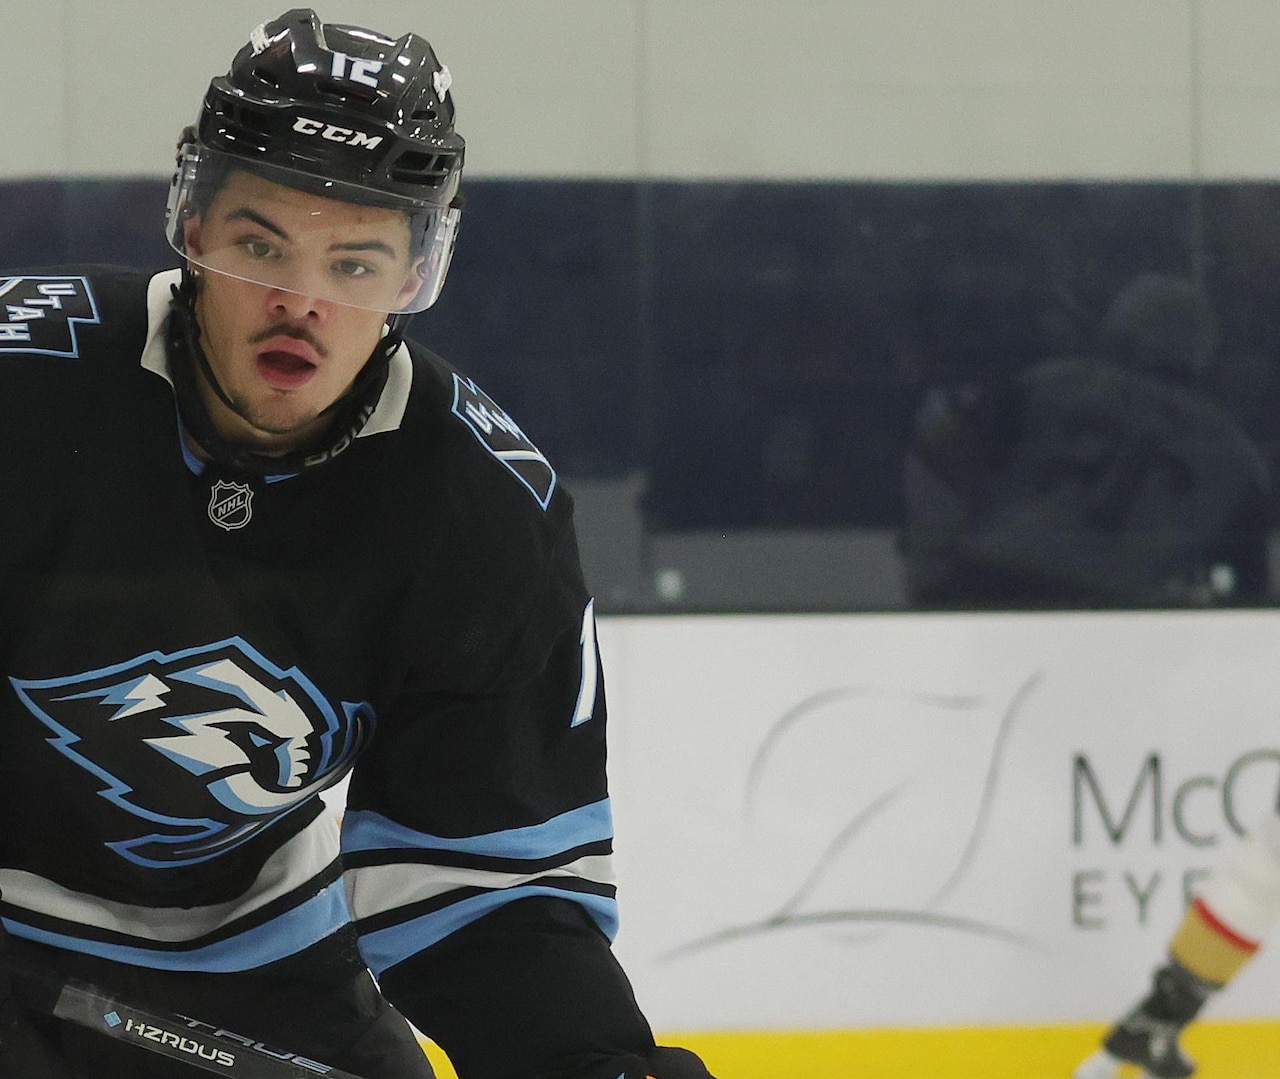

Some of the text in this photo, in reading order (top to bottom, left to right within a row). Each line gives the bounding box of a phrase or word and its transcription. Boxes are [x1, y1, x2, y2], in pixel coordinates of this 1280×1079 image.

[331, 52, 382, 88] 12
[293, 116, 383, 150] CCM
[217, 496, 244, 518] NHL
[125, 1018, 236, 1068] HZRDUS
[175, 1012, 333, 1074] TRUE
